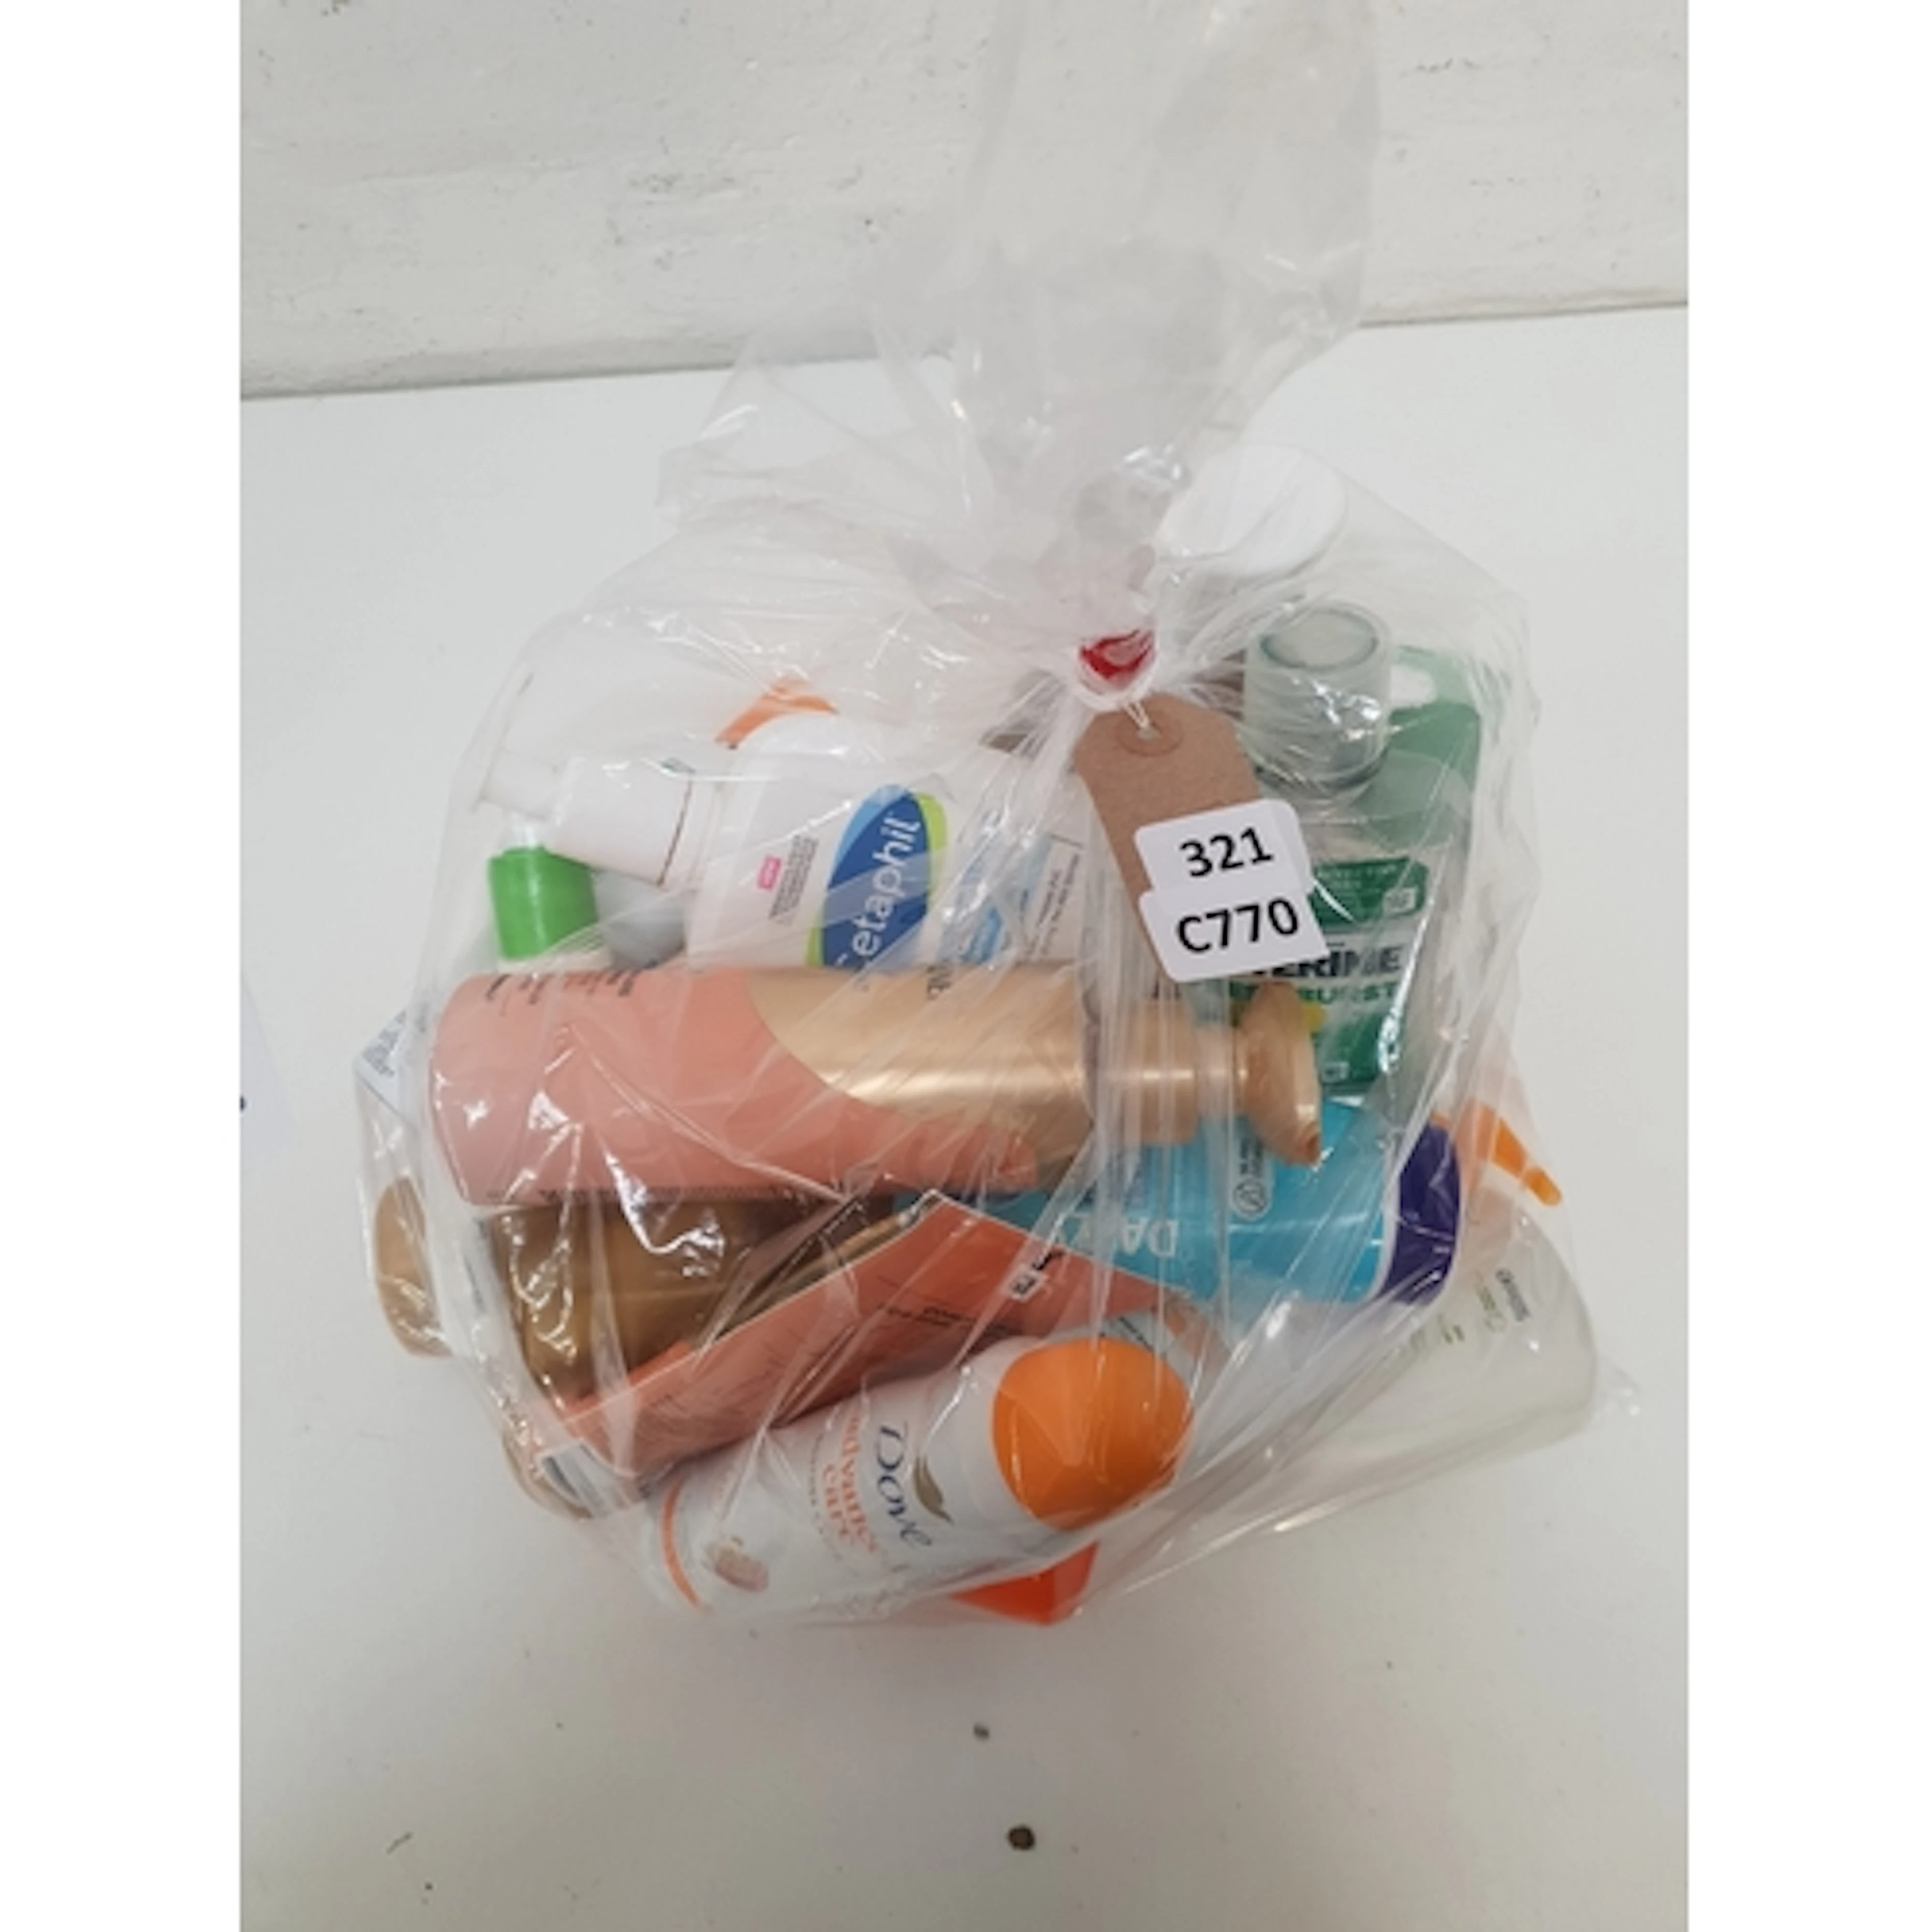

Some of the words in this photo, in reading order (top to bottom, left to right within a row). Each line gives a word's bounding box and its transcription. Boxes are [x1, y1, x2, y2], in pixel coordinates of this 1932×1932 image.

[834, 811, 921, 967] etaphil
[1178, 827, 1274, 877] 321
[1176, 897, 1299, 953] C770
[874, 1423, 932, 1549] Dove
